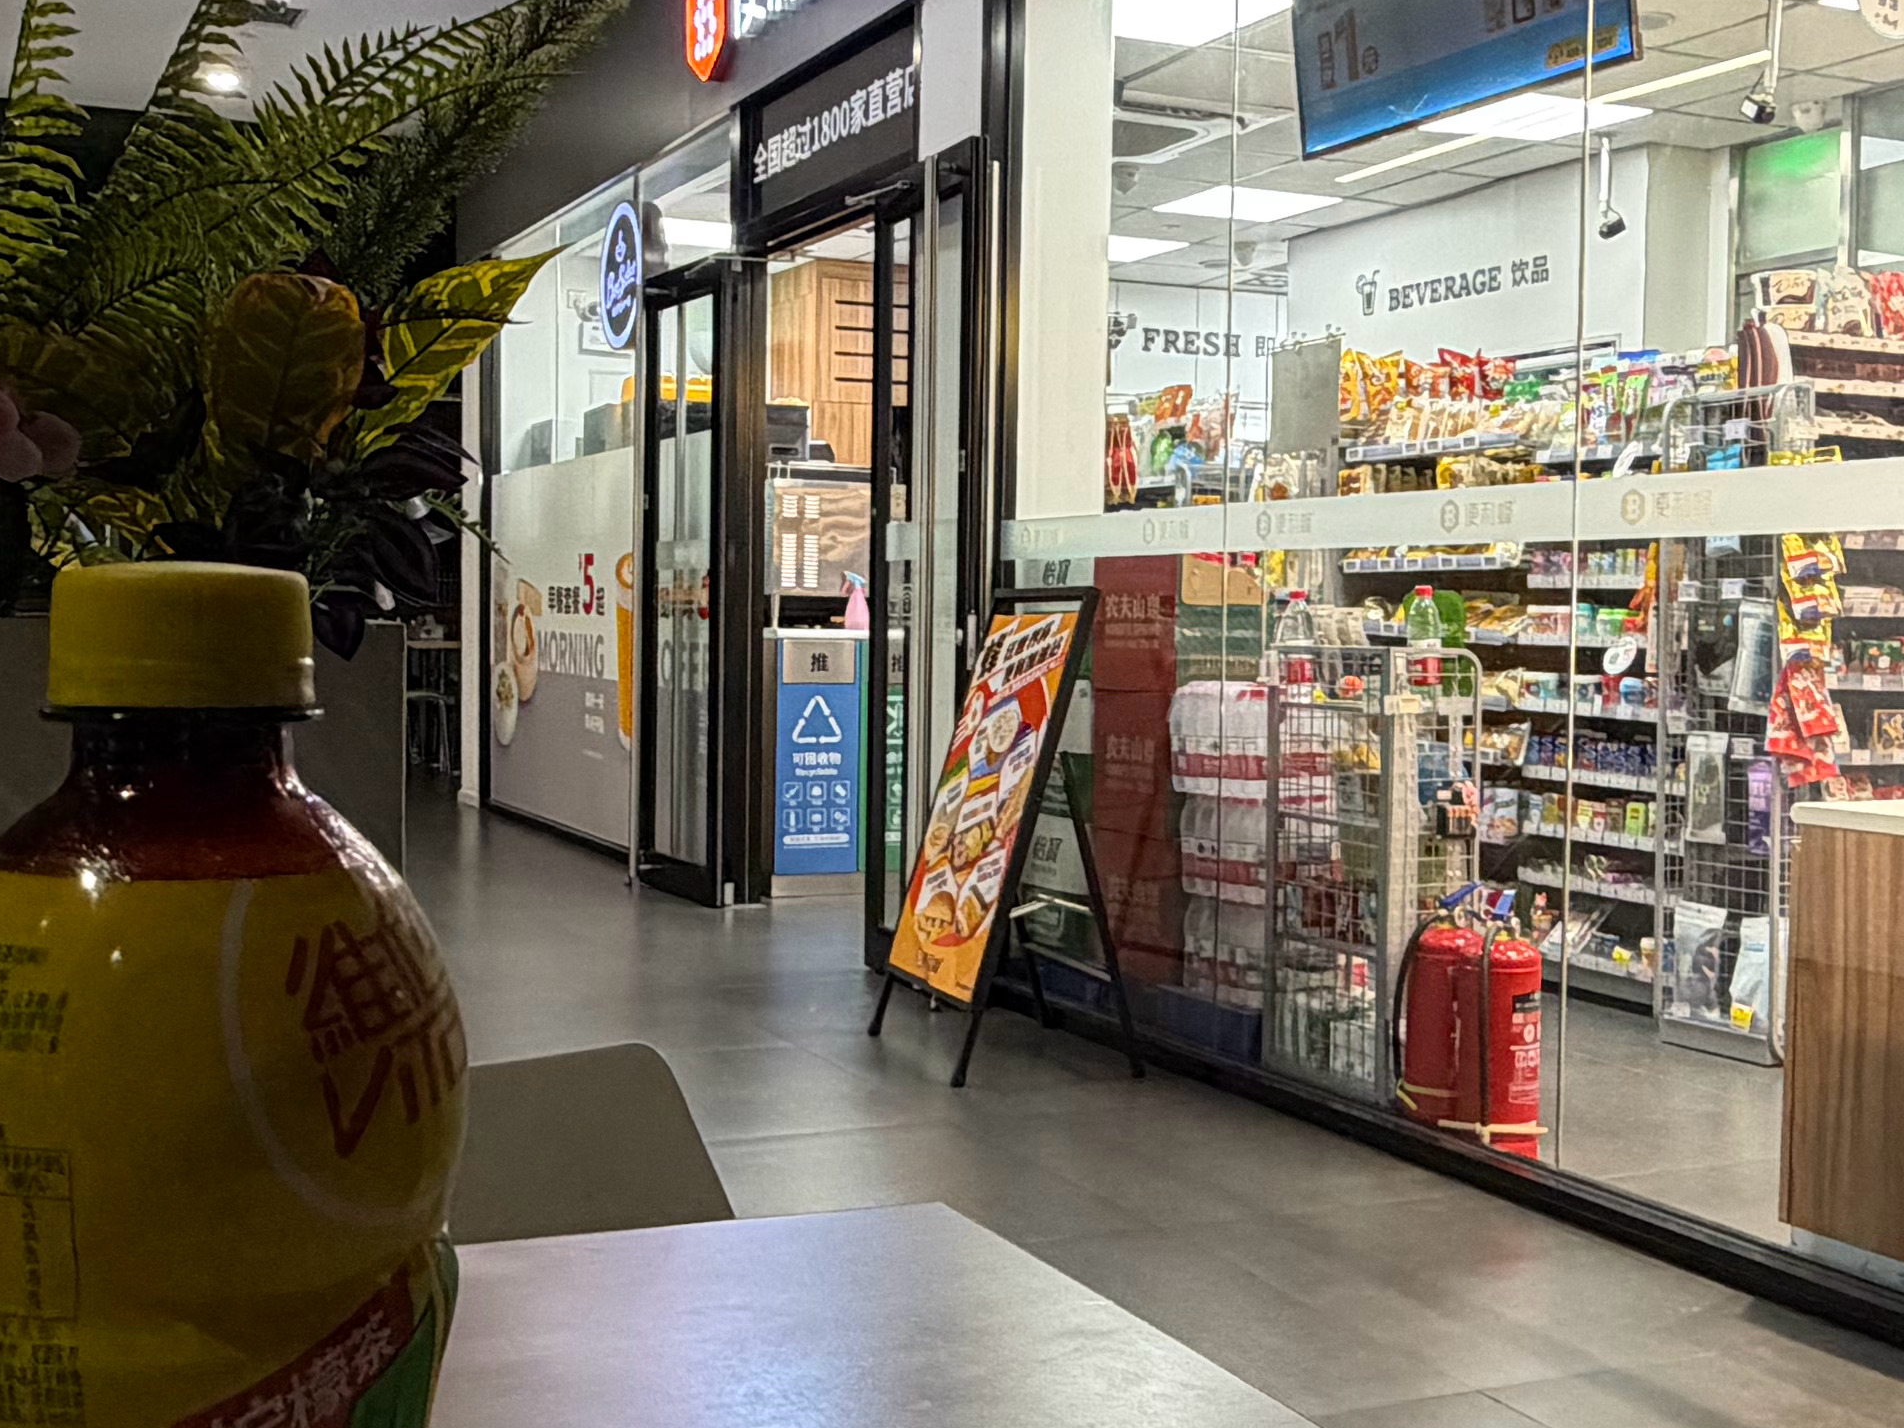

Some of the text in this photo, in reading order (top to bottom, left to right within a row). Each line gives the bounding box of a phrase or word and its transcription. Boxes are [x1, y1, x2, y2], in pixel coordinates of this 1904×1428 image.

[1387, 254, 1550, 312] BEVERAGE 饮品
[1141, 326, 1241, 358] FRESH
[536, 630, 605, 680] MORNING
[809, 652, 829, 674] 推
